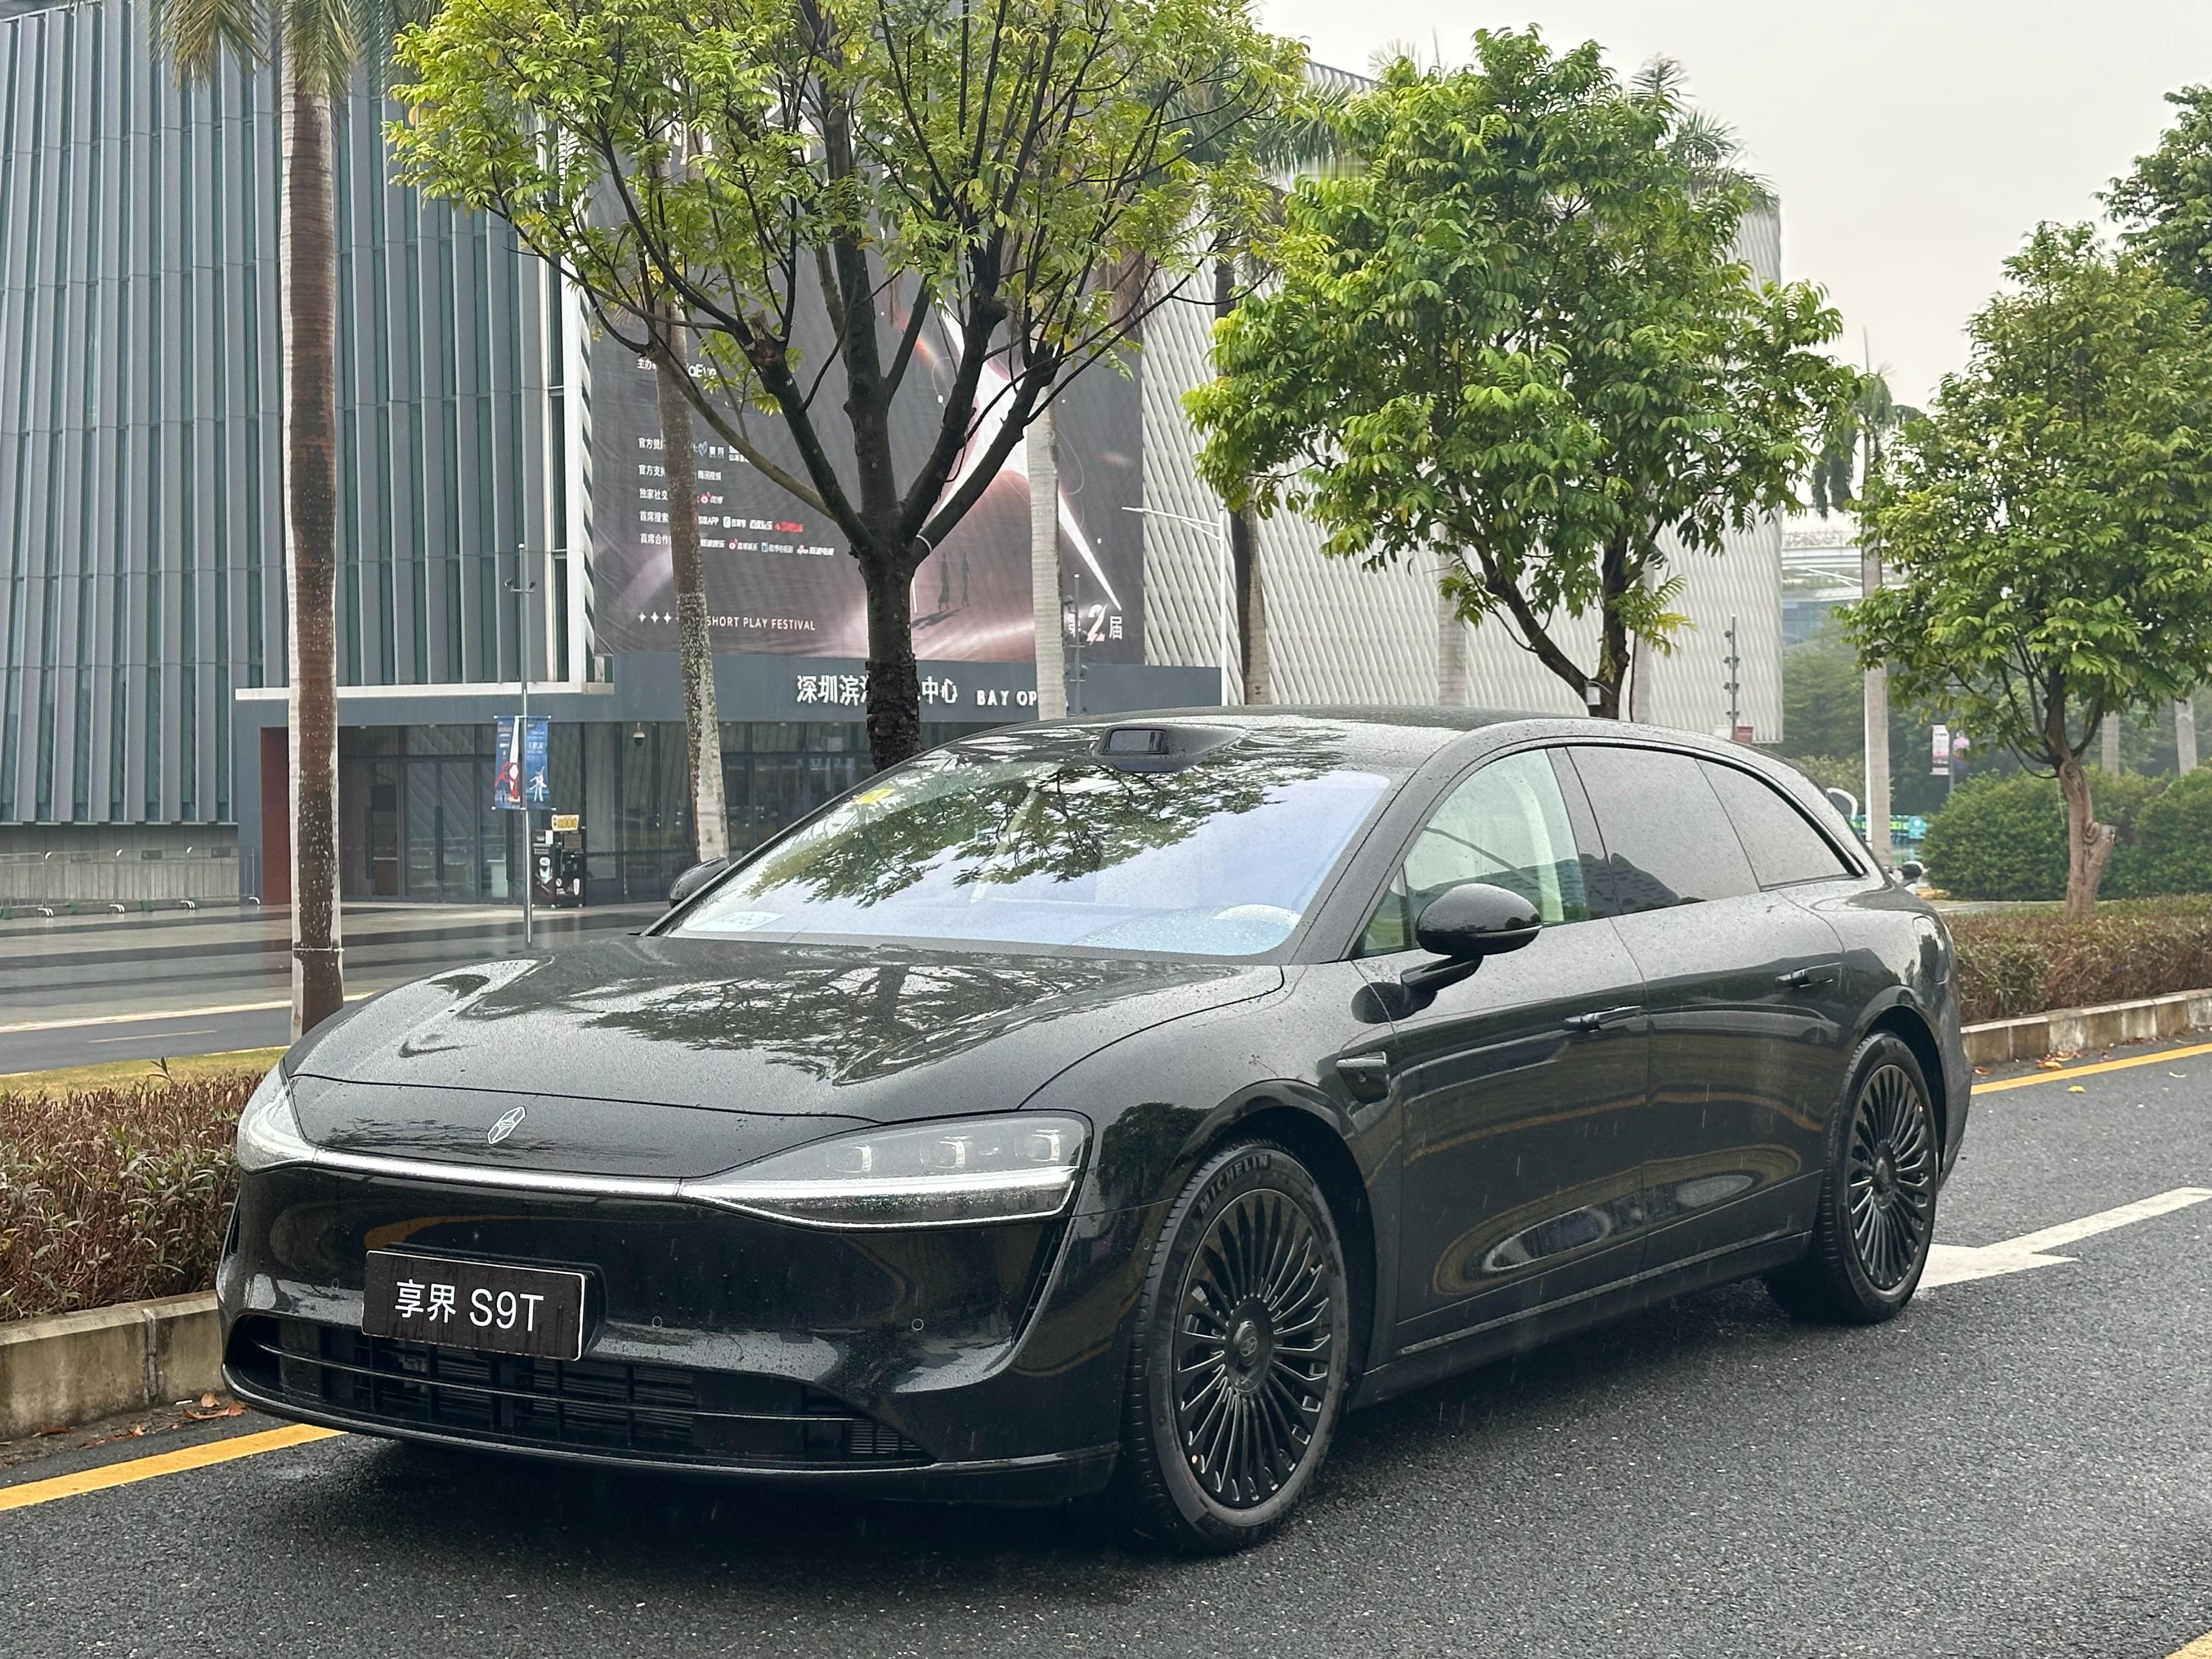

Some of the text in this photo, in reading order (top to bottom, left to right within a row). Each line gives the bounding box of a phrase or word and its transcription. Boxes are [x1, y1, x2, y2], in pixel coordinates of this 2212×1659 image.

[707, 616, 816, 631] SHORT PLAY FESTIVAL
[796, 675, 958, 706] 深圳滨中心
[976, 689, 1037, 706] BAY OP
[1198, 1154, 1271, 1215] MICHELIN
[394, 1278, 544, 1332] 享界 S9T
